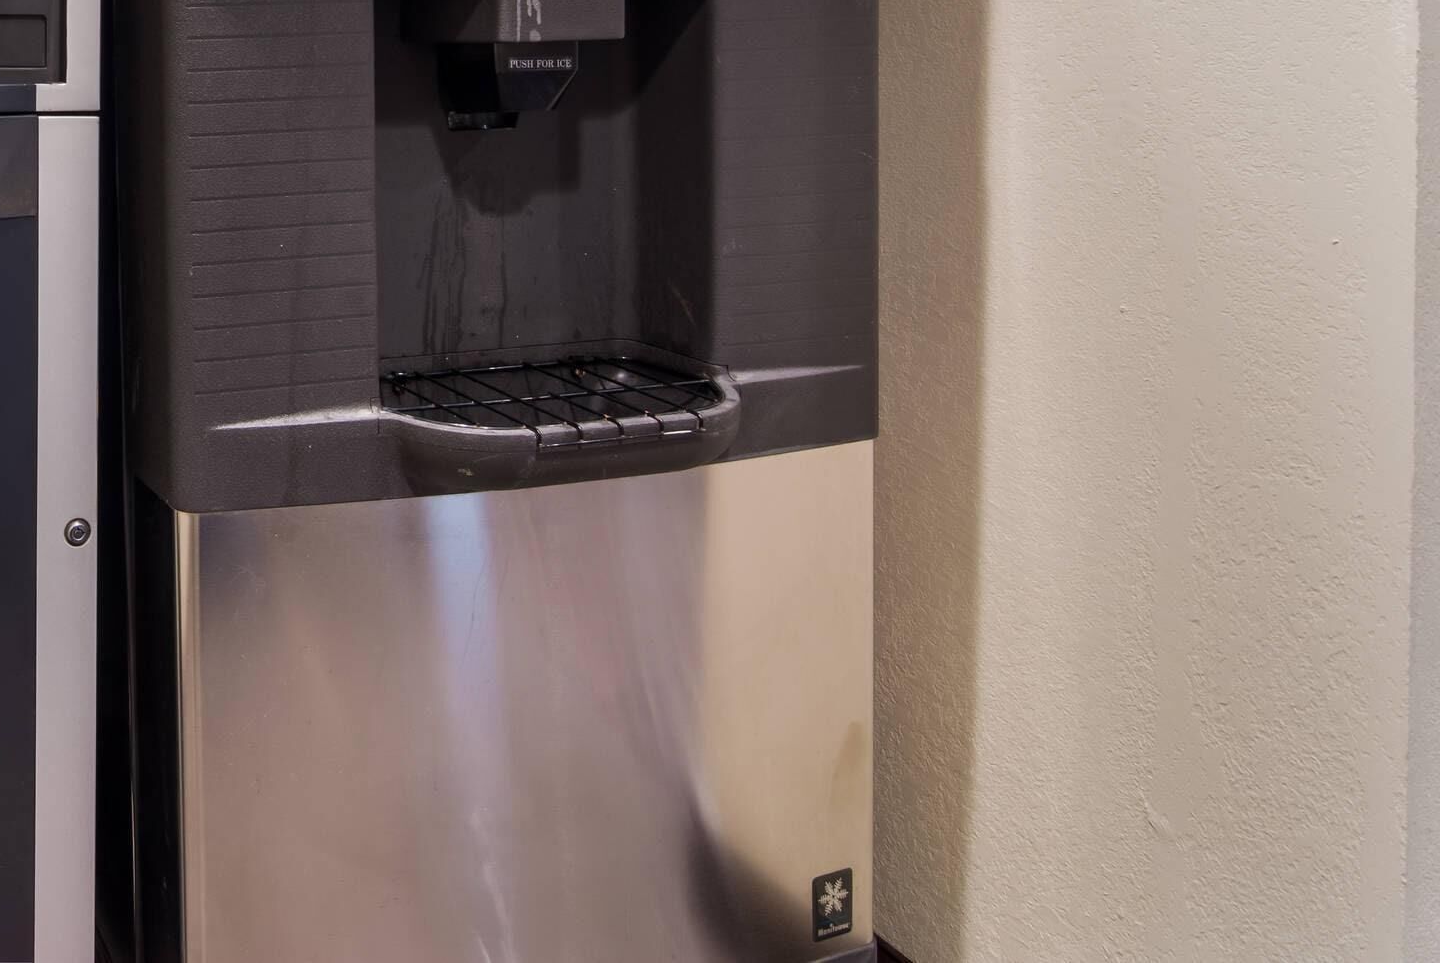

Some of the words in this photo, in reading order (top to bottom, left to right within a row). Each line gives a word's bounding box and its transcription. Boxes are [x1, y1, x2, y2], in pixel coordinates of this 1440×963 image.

[510, 59, 534, 68] PUSH
[536, 59, 554, 68] FOR
[557, 59, 572, 68] ICE
